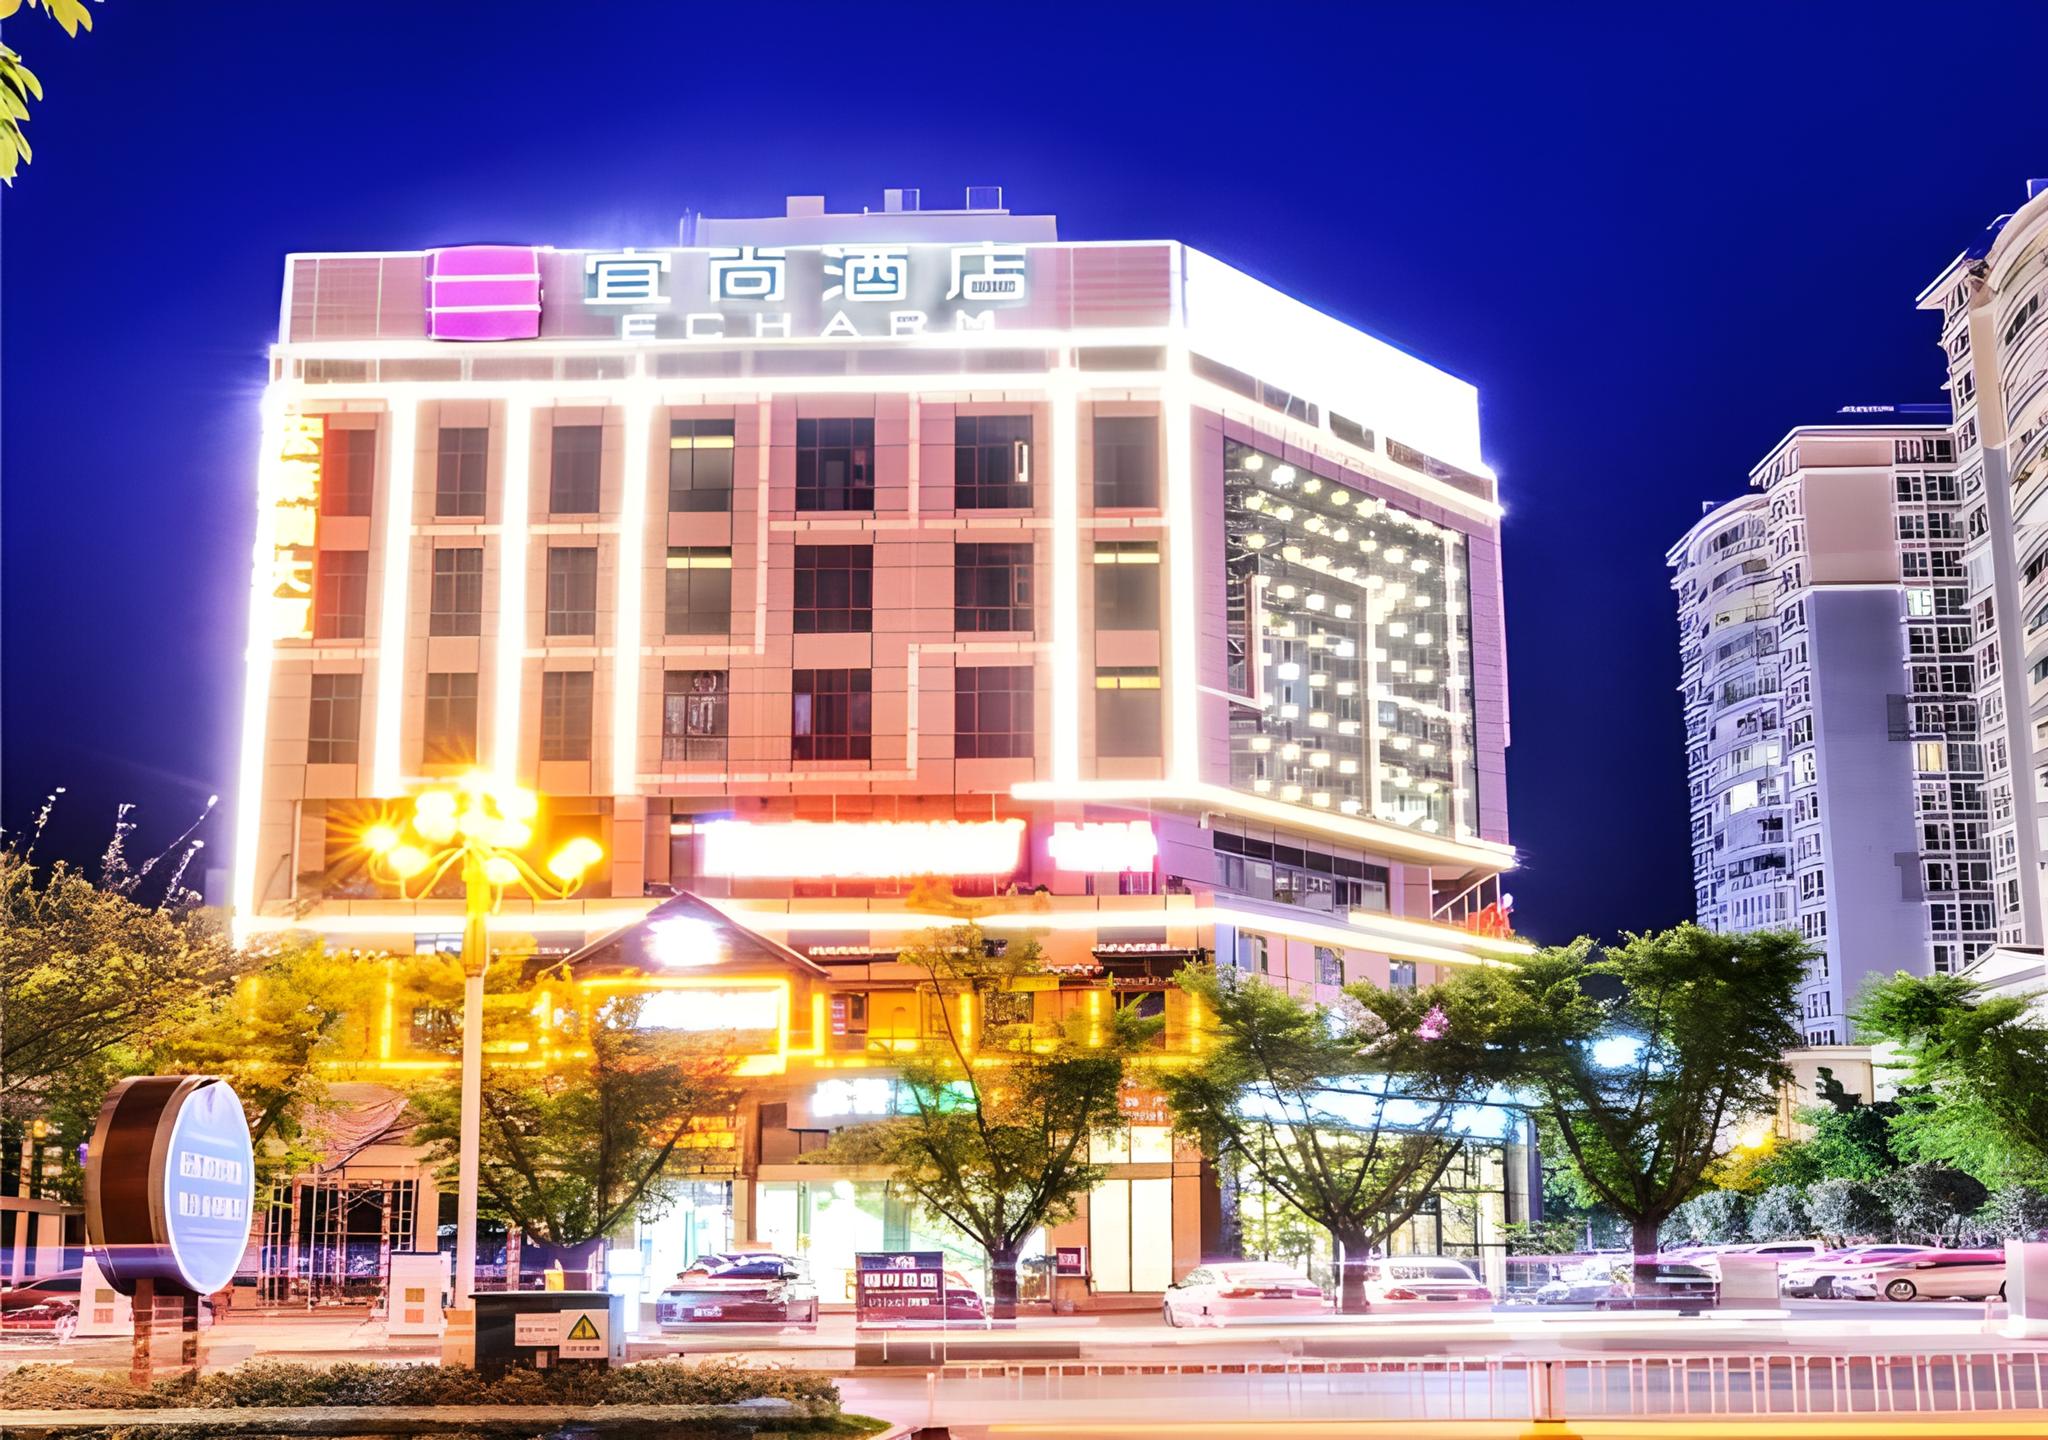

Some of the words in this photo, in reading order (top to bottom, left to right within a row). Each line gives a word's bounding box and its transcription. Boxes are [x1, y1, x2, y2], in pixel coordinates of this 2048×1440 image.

[584, 242, 1026, 304] 宜尚酒店
[621, 309, 996, 340] ECHARM
